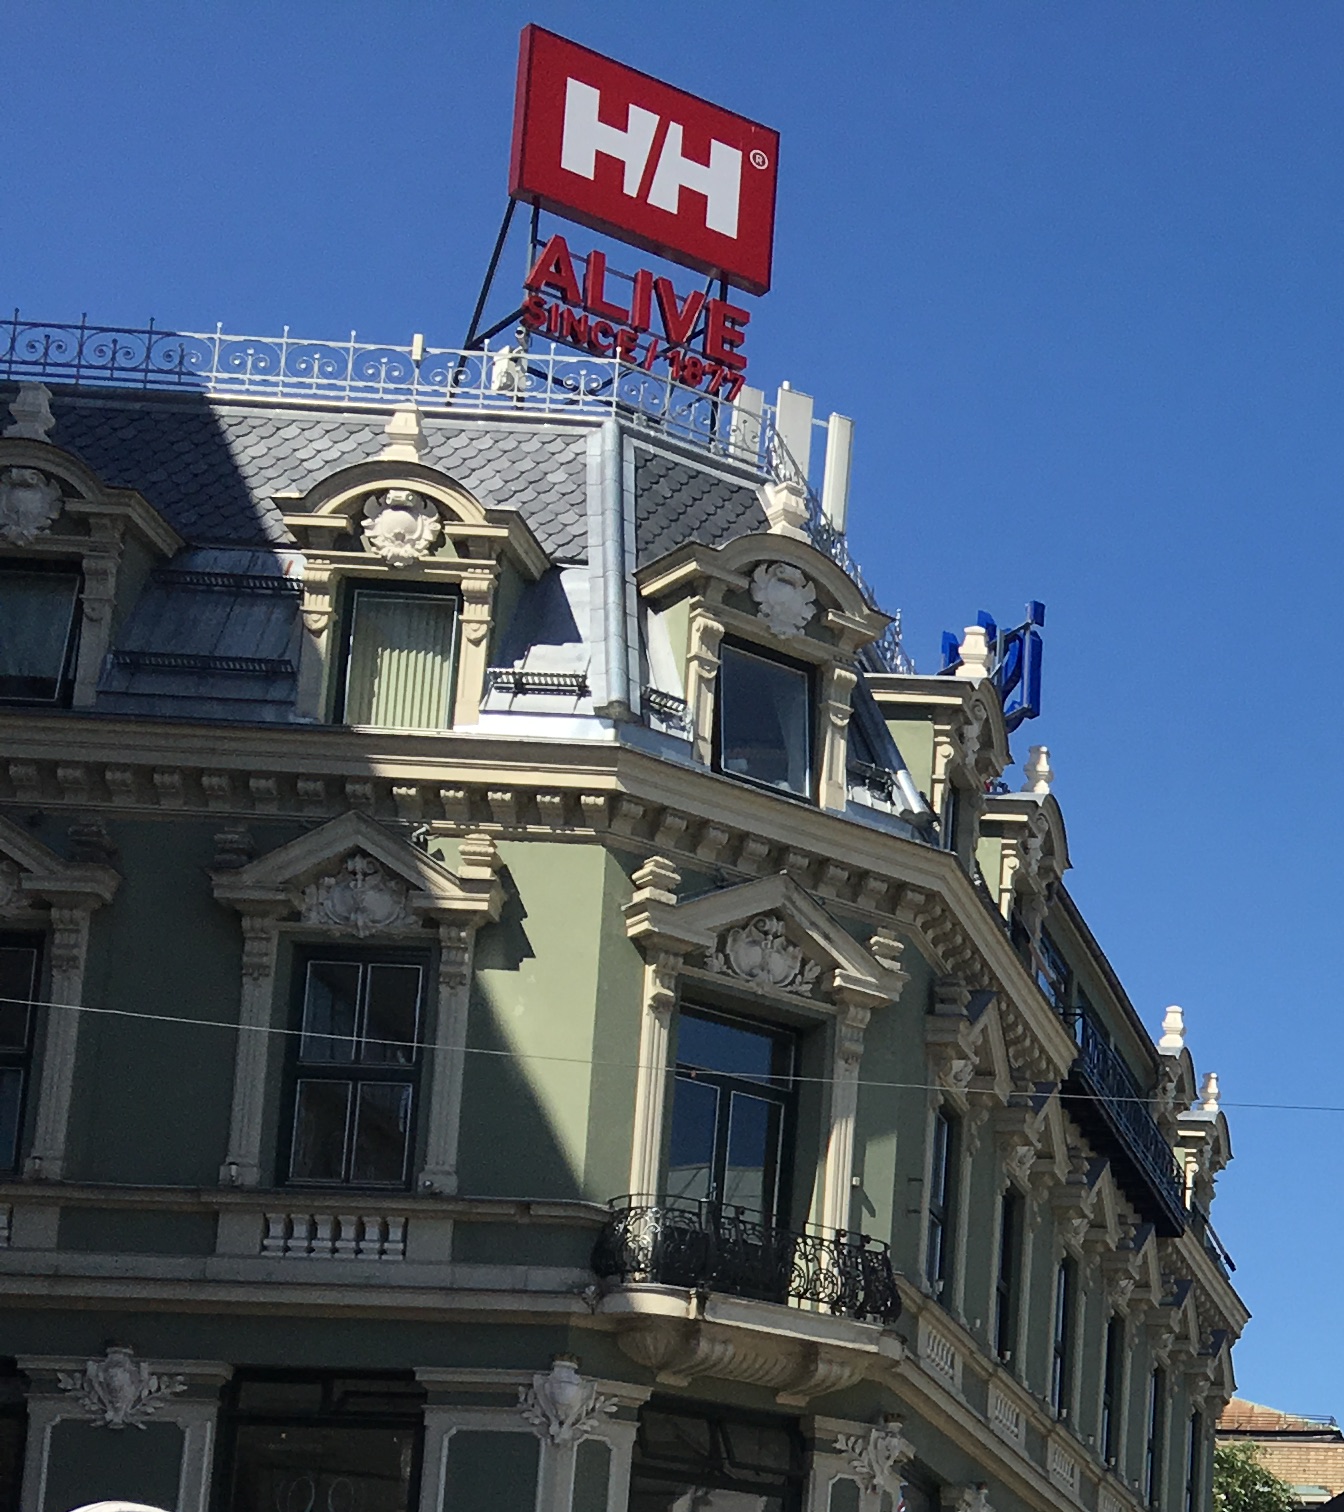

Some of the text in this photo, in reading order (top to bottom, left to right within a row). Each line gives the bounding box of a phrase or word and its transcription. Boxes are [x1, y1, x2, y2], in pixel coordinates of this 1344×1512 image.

[520, 294, 639, 363] SINCE
[668, 350, 747, 401] 1877
[525, 234, 751, 370] ALIVE
